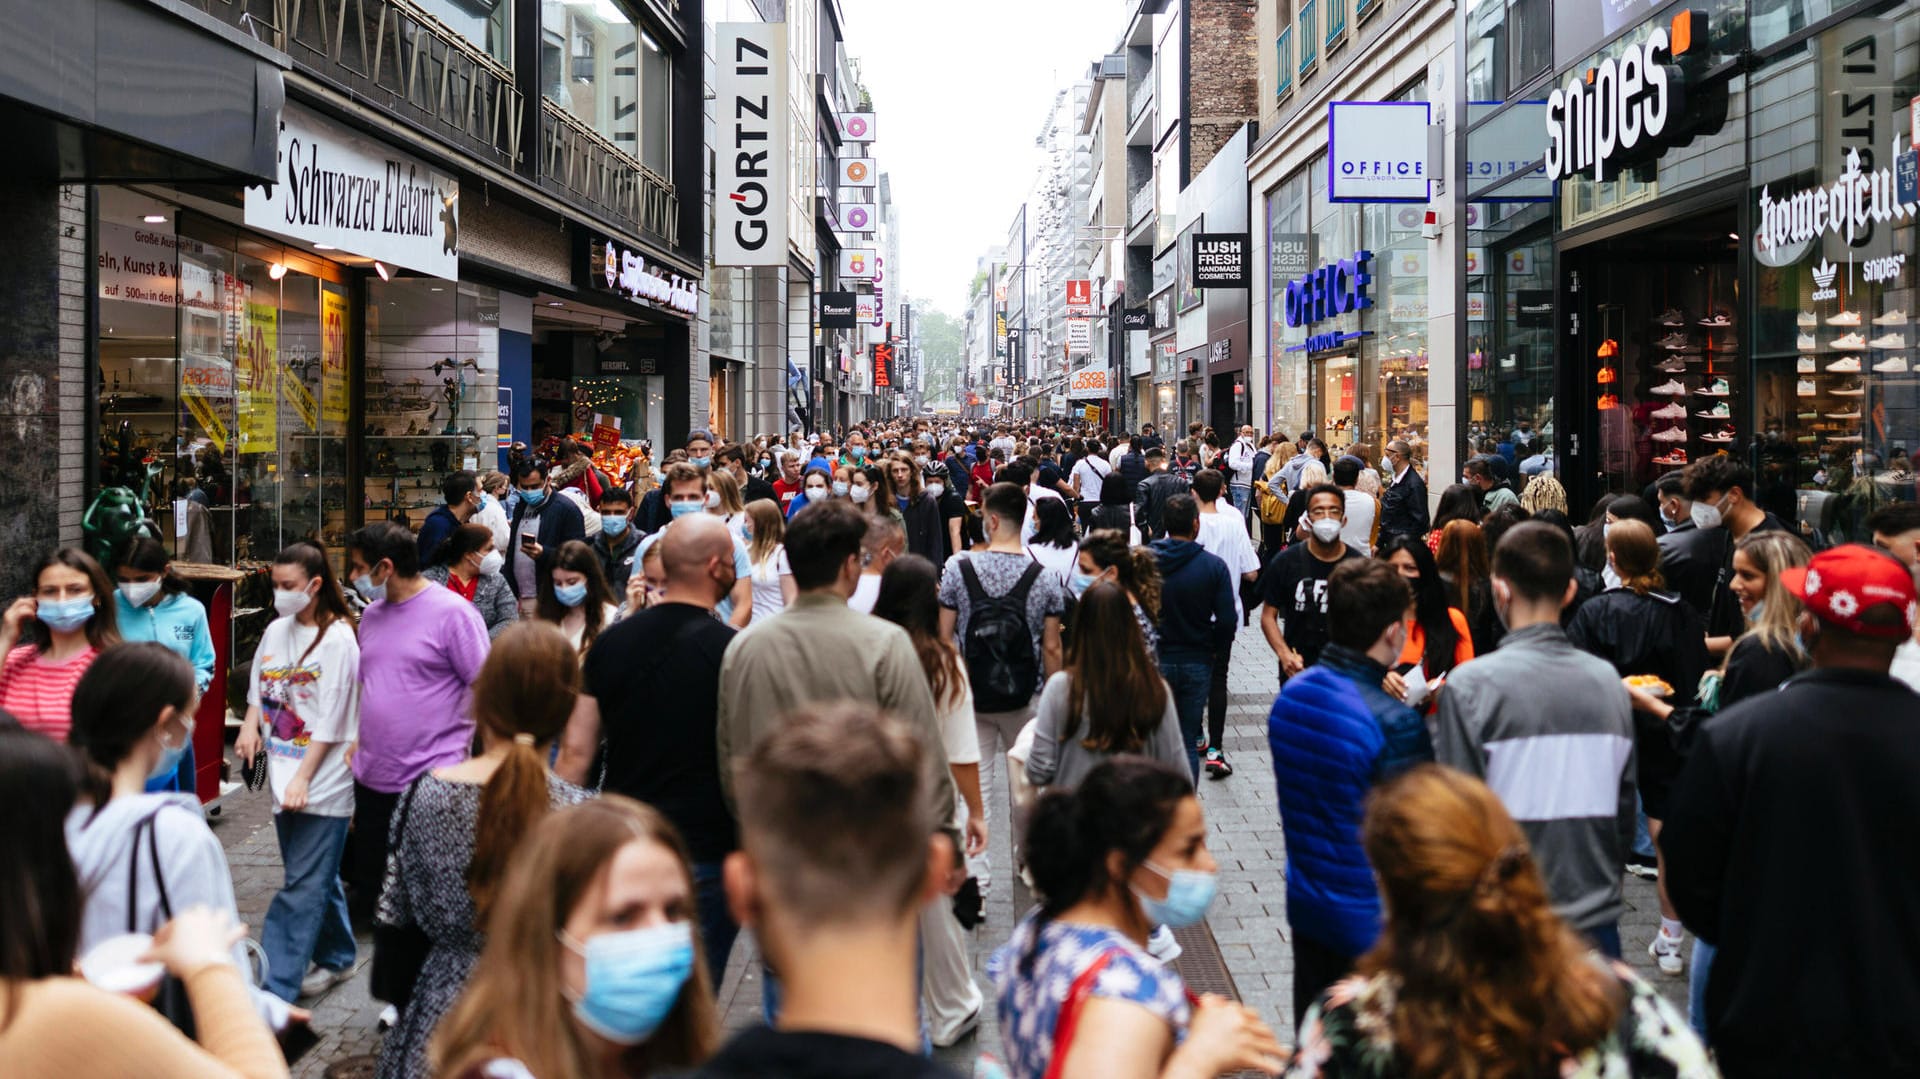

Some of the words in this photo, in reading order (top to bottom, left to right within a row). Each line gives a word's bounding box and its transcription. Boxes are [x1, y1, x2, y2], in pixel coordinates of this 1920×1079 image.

[735, 37, 768, 75] 17
[1545, 27, 1669, 183] snipes
[1341, 161, 1423, 175] OFFICE
[285, 138, 380, 232] Schwarzer
[382, 159, 435, 237] Elefant
[135, 231, 159, 246] Große
[1198, 241, 1241, 253] LUSH
[123, 256, 156, 276] Kunst
[159, 261, 167, 278] &
[1198, 255, 1241, 265] FRESH
[1863, 256, 1901, 284] snipes
[104, 284, 119, 296] auf
[159, 291, 173, 303] den
[1285, 250, 1371, 328] OFFICE
[1812, 288, 1837, 301] adidas
[1079, 371, 1106, 380] FOOD
[1072, 380, 1107, 389] LOUNGE
